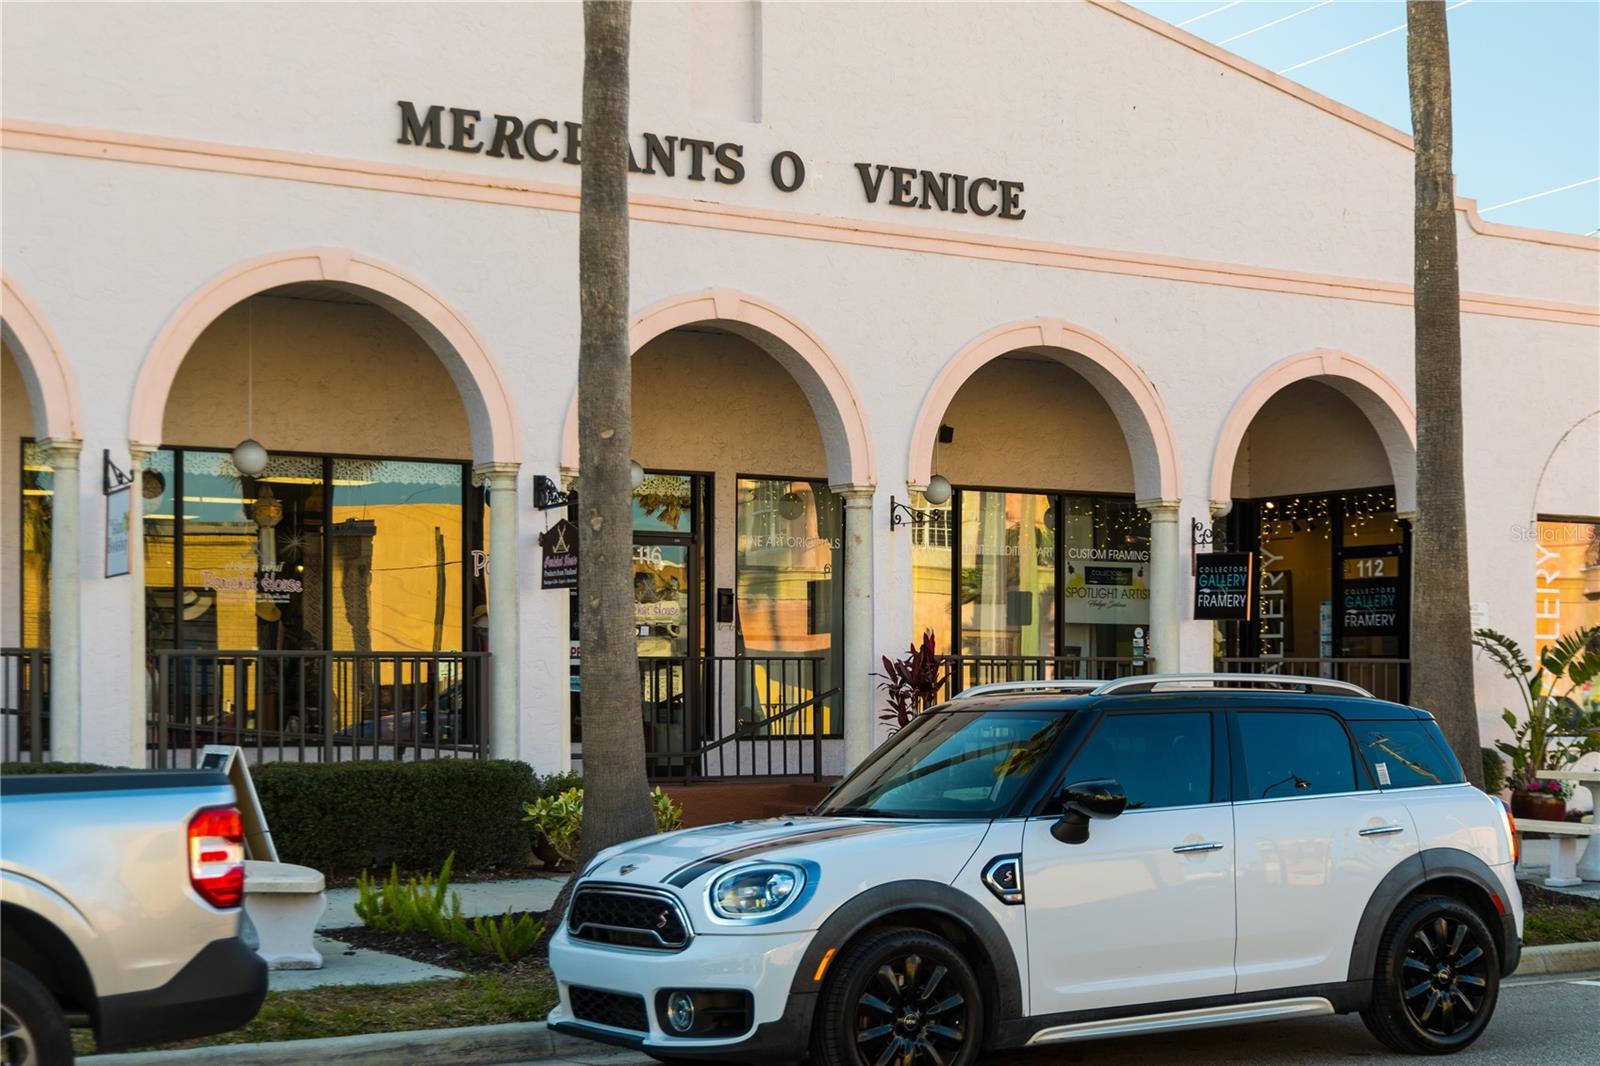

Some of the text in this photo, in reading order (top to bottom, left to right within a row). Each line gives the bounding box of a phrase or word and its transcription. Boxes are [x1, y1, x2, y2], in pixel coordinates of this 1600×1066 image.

[771, 150, 806, 193] O
[854, 162, 1027, 220] VENICE
[786, 536, 841, 550] ORIGALS
[962, 543, 999, 556] LIMITE
[637, 546, 663, 566] 116
[1068, 547, 1149, 561] CUSTOM FRAMING
[1356, 560, 1384, 577] 112
[1199, 574, 1247, 587] GALLERY
[1065, 586, 1118, 599] SPOTLIGHT
[1198, 594, 1246, 607] FRAMERY
[1344, 595, 1396, 608] GALLERY
[1344, 614, 1396, 627] FRAMERY
